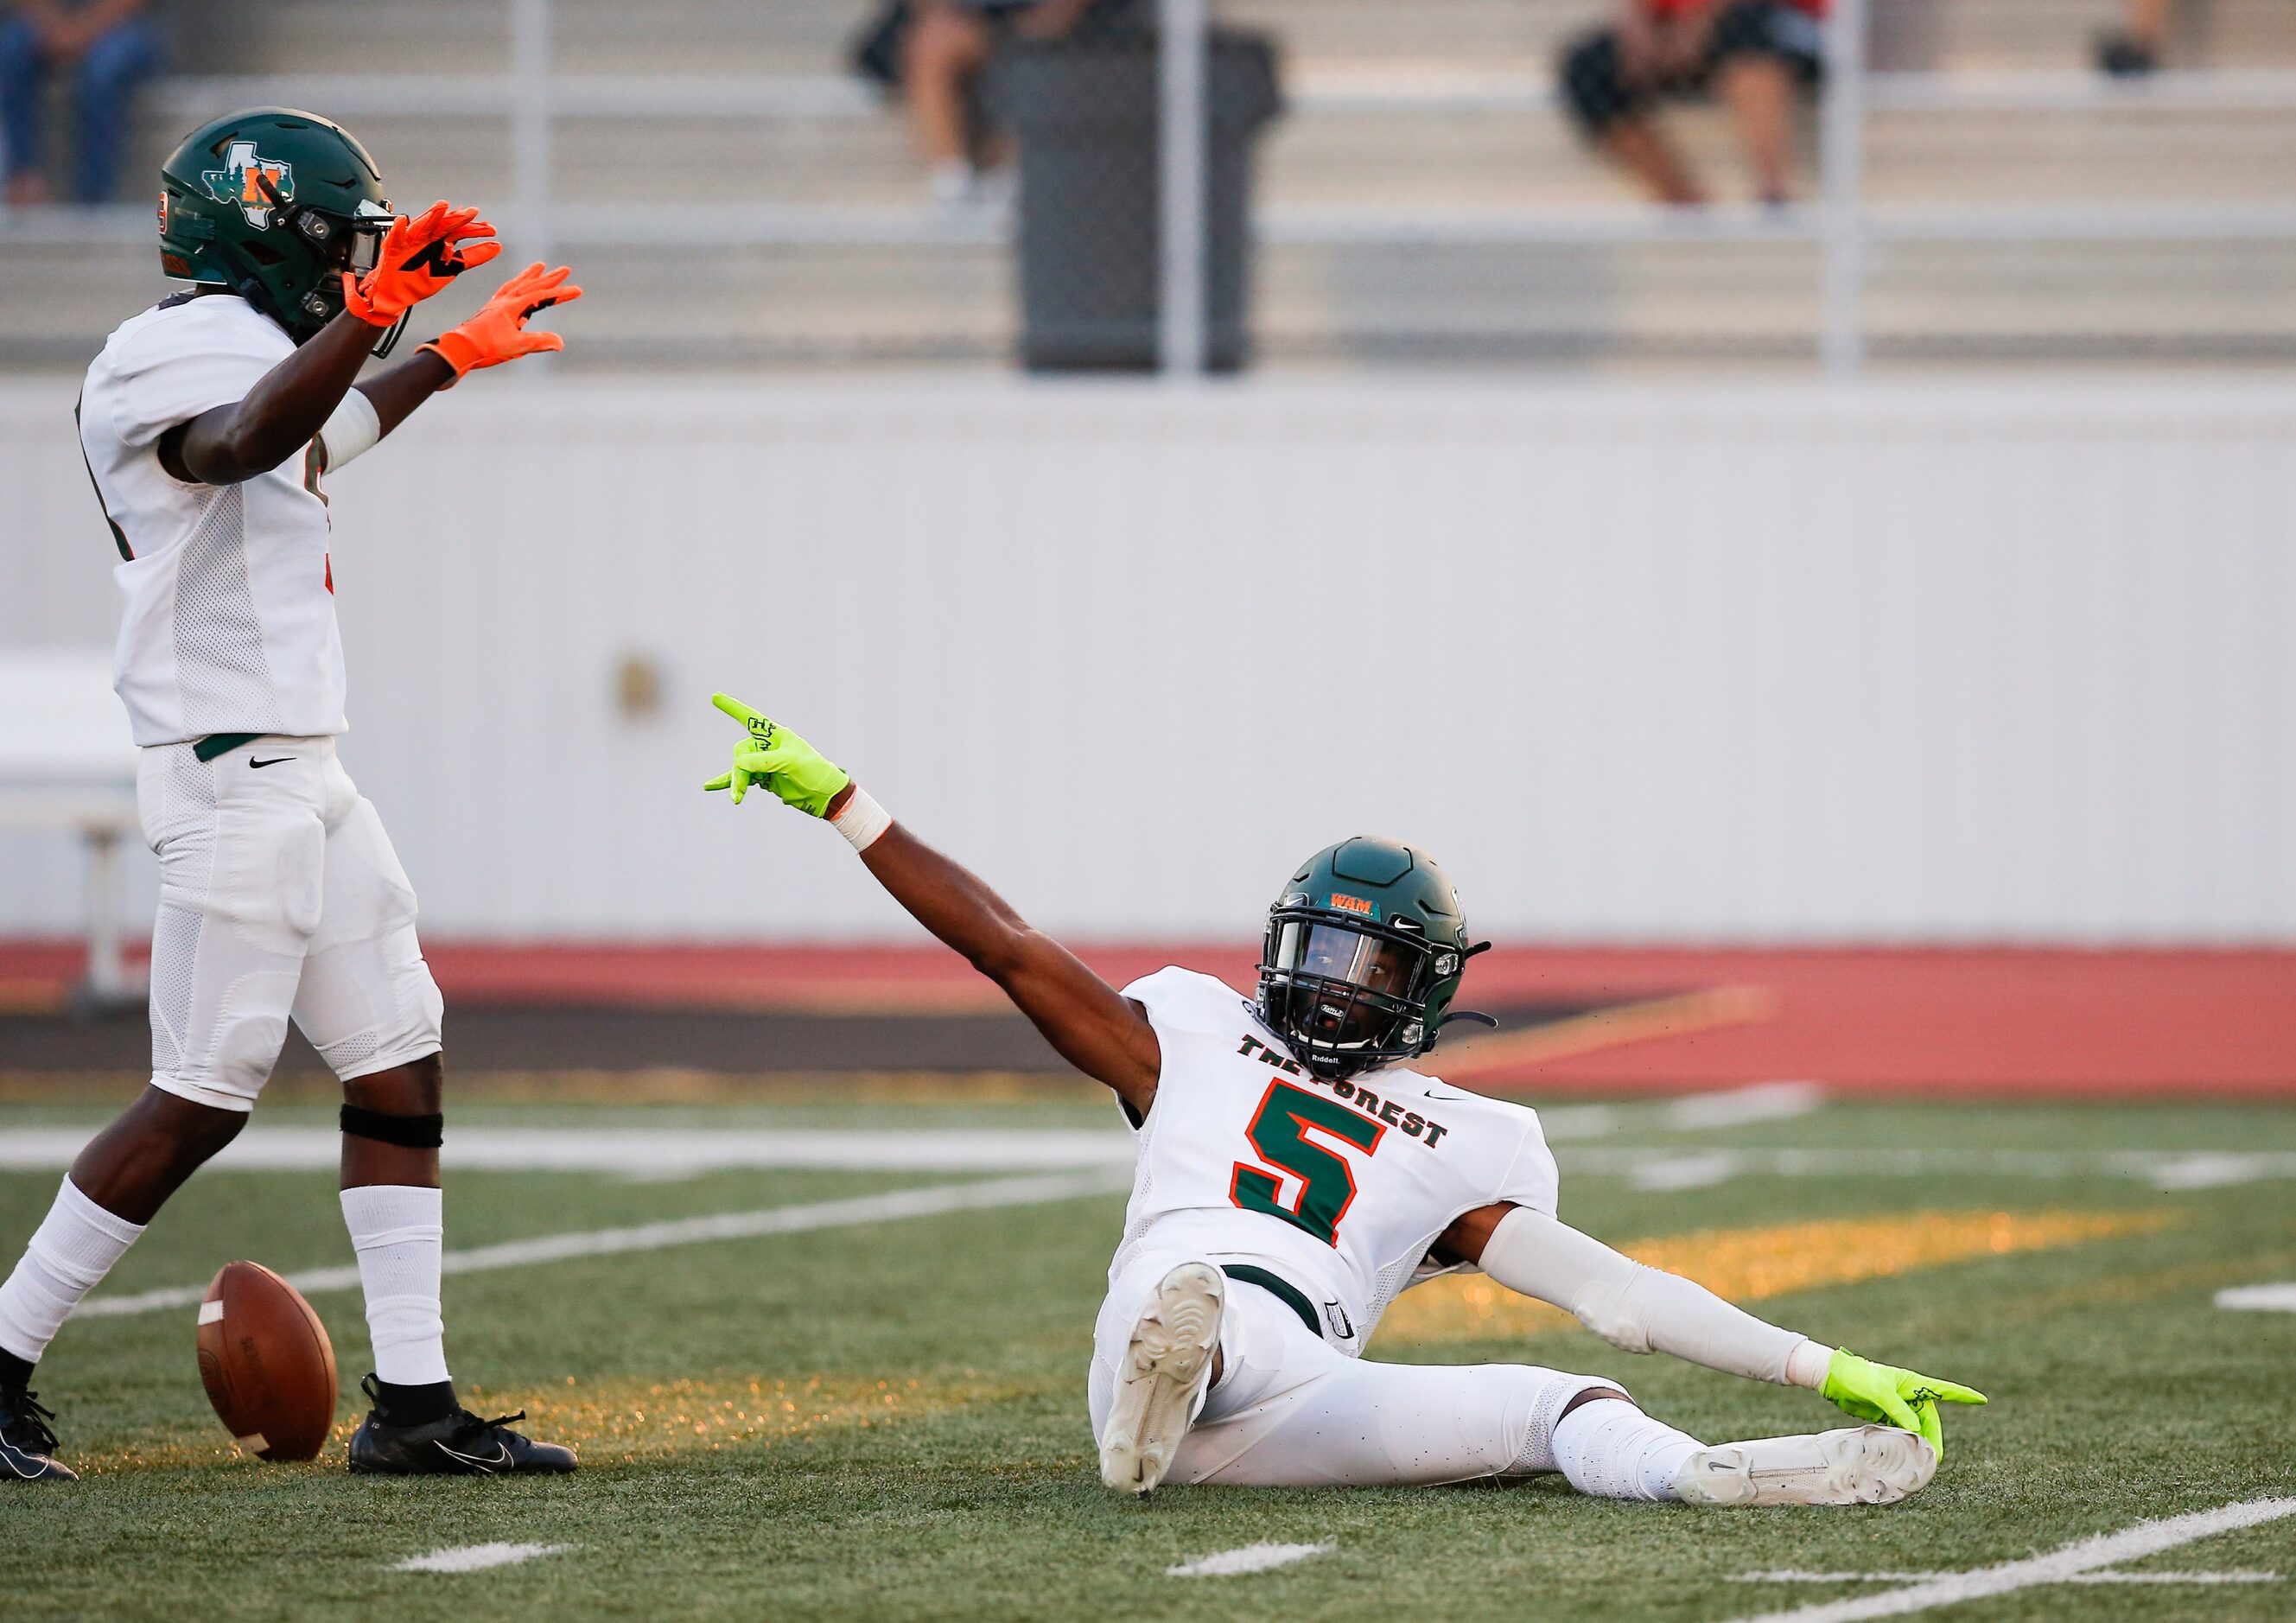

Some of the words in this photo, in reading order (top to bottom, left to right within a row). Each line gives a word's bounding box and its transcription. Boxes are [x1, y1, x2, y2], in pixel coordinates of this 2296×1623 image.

[241, 167, 281, 203] N
[1331, 893, 1372, 914] WAM
[1312, 1054, 1339, 1064] Riddell
[1309, 1076, 1448, 1149] OREST
[1228, 1076, 1389, 1250] 5
